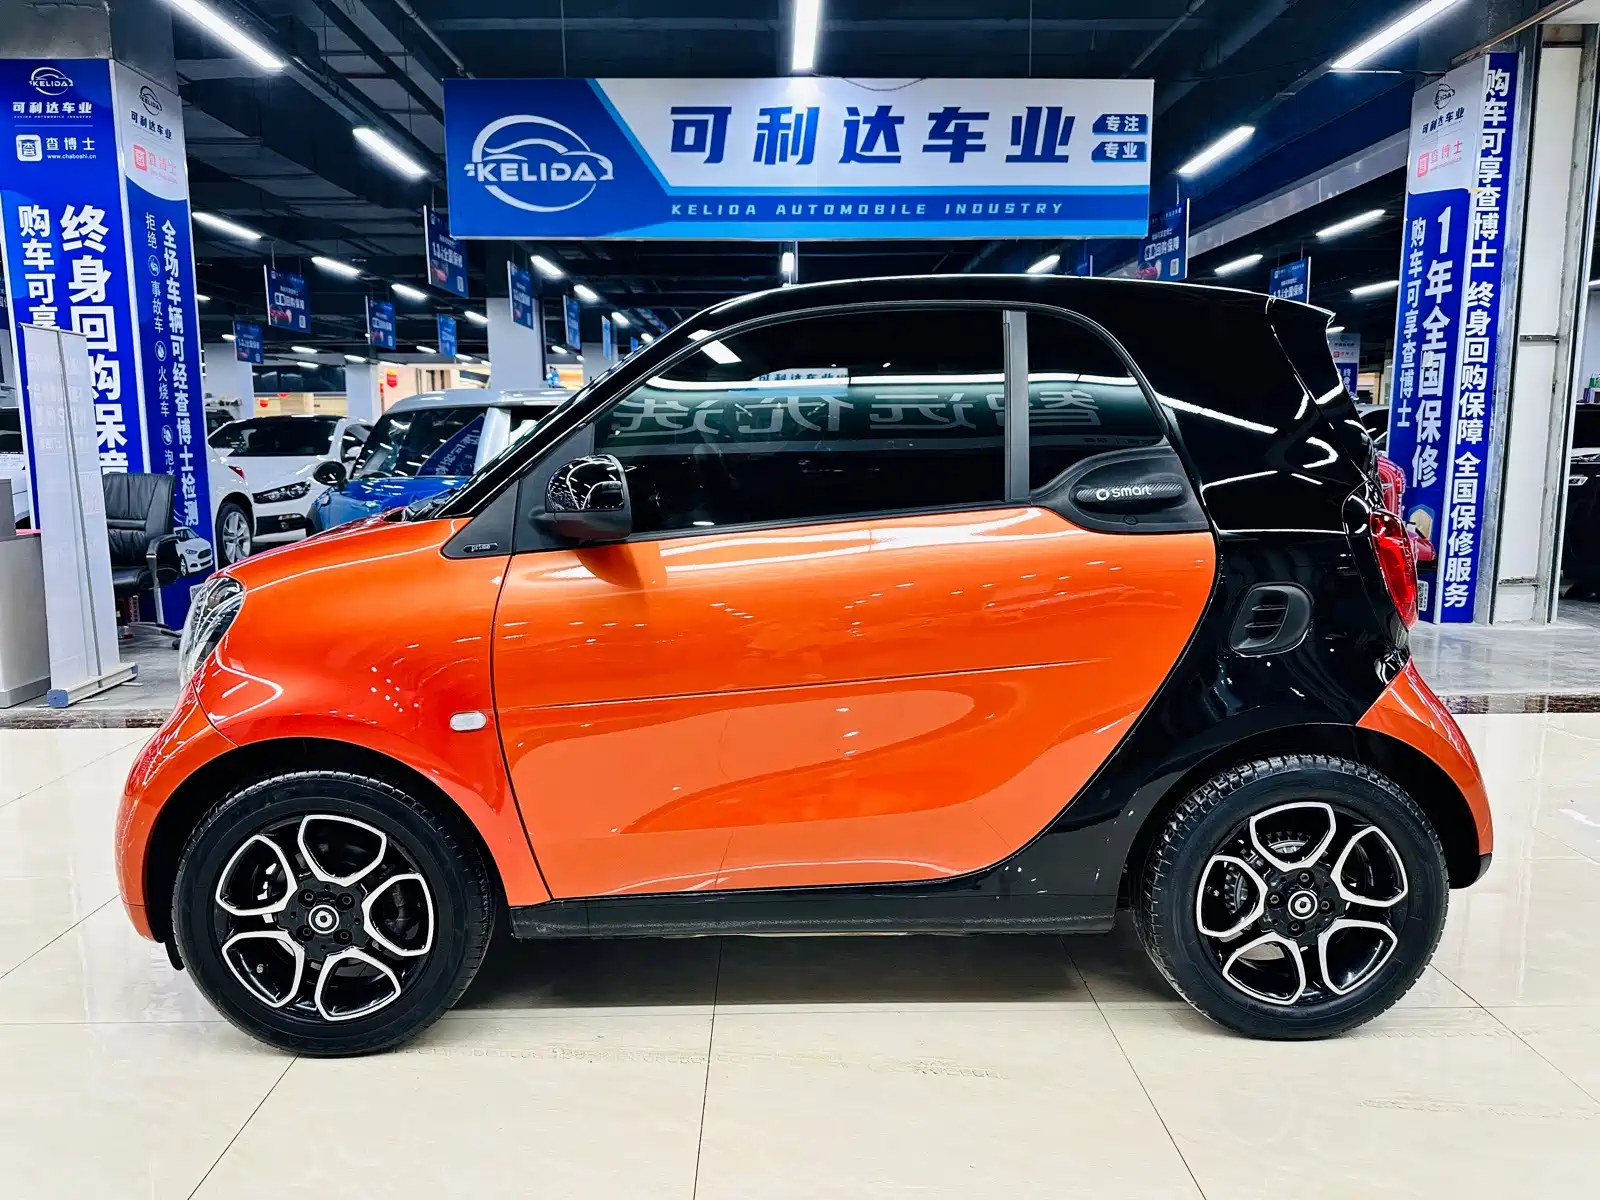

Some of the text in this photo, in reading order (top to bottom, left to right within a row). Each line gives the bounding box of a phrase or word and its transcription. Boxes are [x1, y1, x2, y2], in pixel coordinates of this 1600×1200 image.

[12, 101, 92, 114] 可利达车业
[131, 110, 172, 140] 可利达车业
[670, 104, 1076, 166] 可利达车业
[1105, 115, 1140, 133] 专注
[46, 137, 95, 151] 查博士
[1103, 141, 1139, 160] 专业
[478, 162, 597, 182] KELIDA
[671, 202, 1064, 216] KELIDA AUTOMOBILE INDUSTRY
[145, 212, 158, 249] 拒绝
[150, 279, 164, 333] 事故车
[1396, 216, 1427, 428] 购车可享查博士
[1411, 205, 1453, 489] 1年全国保修
[1443, 68, 1510, 609] 购车可享查博士 终身回购保障 全国保修服务
[161, 219, 199, 527] 全场车辆可经查博士检测
[157, 366, 171, 418] 火烧车
[1112, 484, 1153, 498] smart
[470, 543, 491, 552] prime
